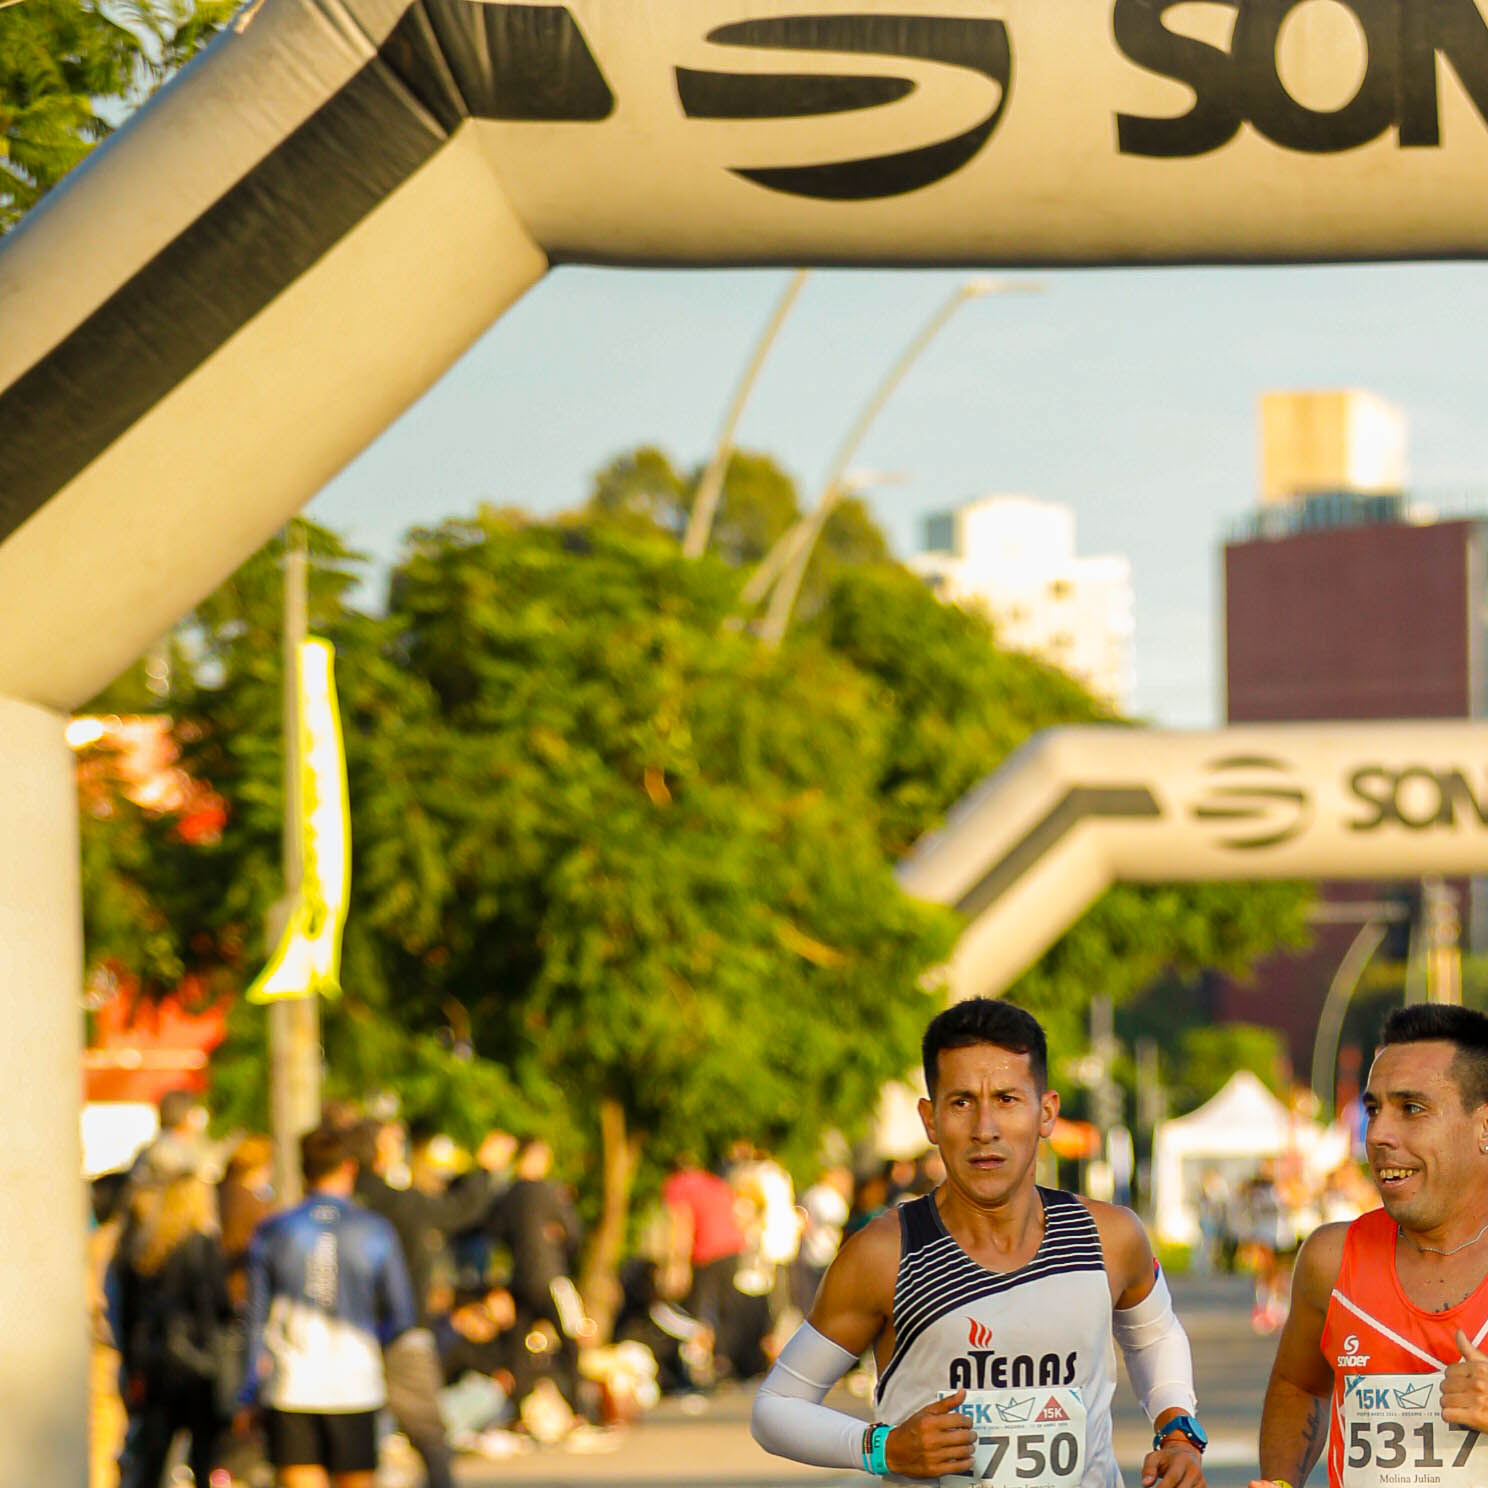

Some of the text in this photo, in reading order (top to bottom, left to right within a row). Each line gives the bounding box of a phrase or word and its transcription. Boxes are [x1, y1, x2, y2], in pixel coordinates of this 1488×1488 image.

[1356, 1388, 1390, 1409] 15K
[1043, 1408, 1063, 1419] 15K
[950, 1432, 1078, 1479] 750
[1348, 1422, 1483, 1468] 5317
[1380, 1474, 1441, 1484] Molina Julian
